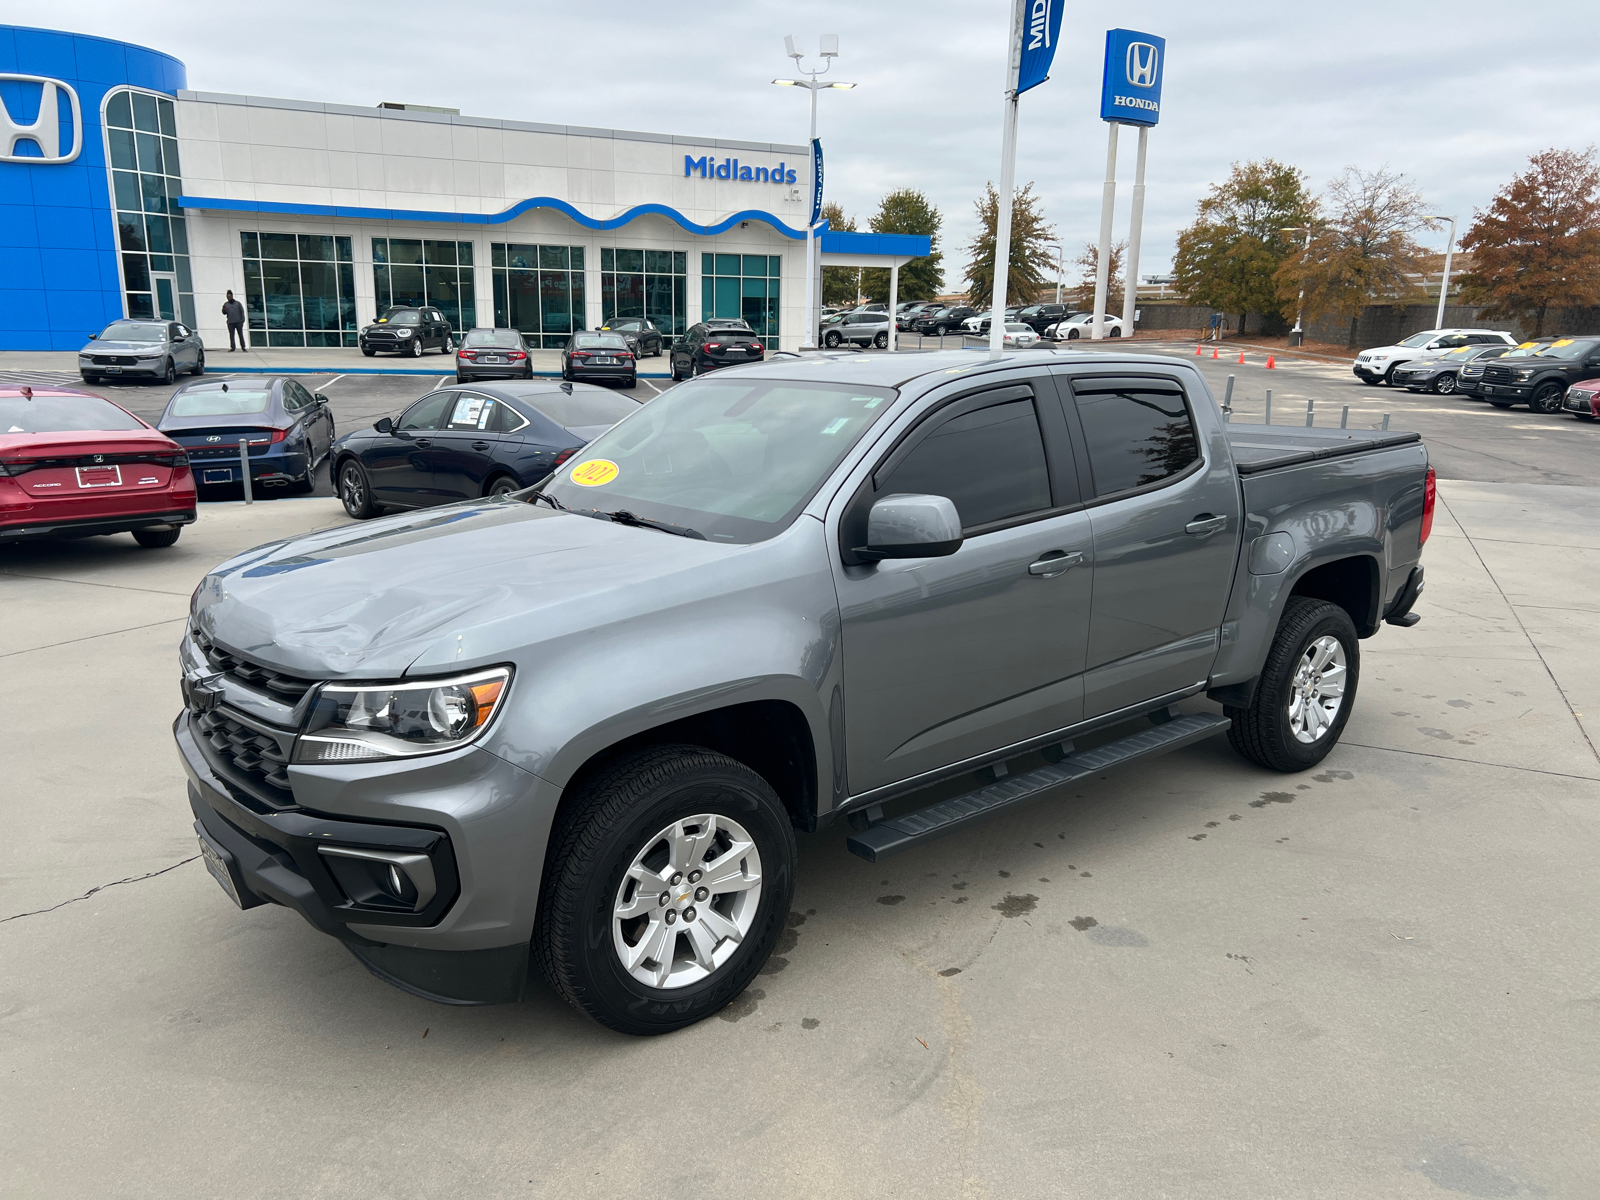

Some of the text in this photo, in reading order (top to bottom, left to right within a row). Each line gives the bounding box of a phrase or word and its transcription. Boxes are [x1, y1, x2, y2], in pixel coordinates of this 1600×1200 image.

[1114, 95, 1160, 112] HONDA
[684, 154, 798, 185] Midlands
[575, 463, 614, 481] 2021
